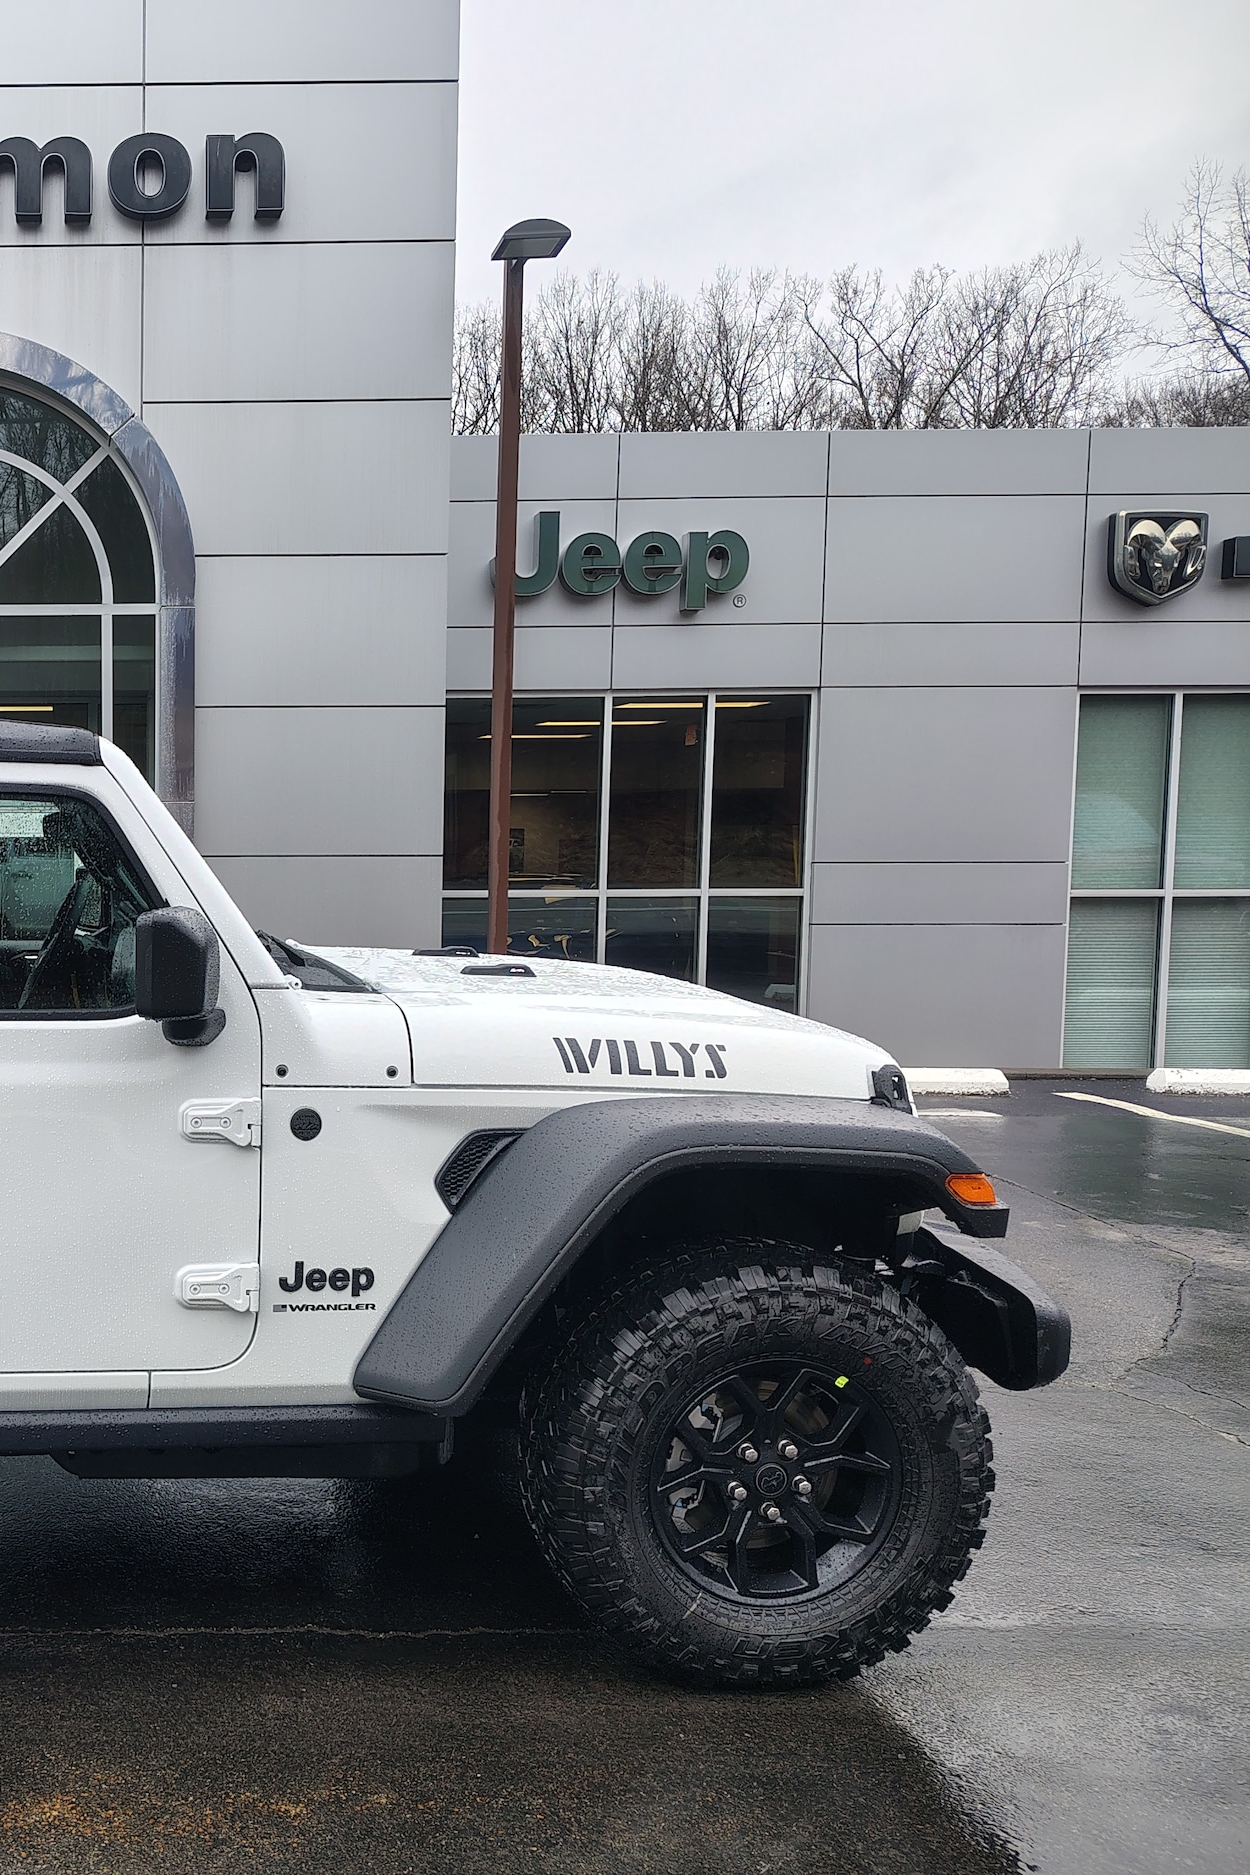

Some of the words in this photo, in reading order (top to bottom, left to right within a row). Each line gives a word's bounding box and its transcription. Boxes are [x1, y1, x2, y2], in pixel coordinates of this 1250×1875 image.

[490, 511, 750, 613] Jeep
[552, 1037, 728, 1079] WILLYS
[278, 1260, 375, 1297] Jeep
[288, 1303, 377, 1312] WRANGLER
